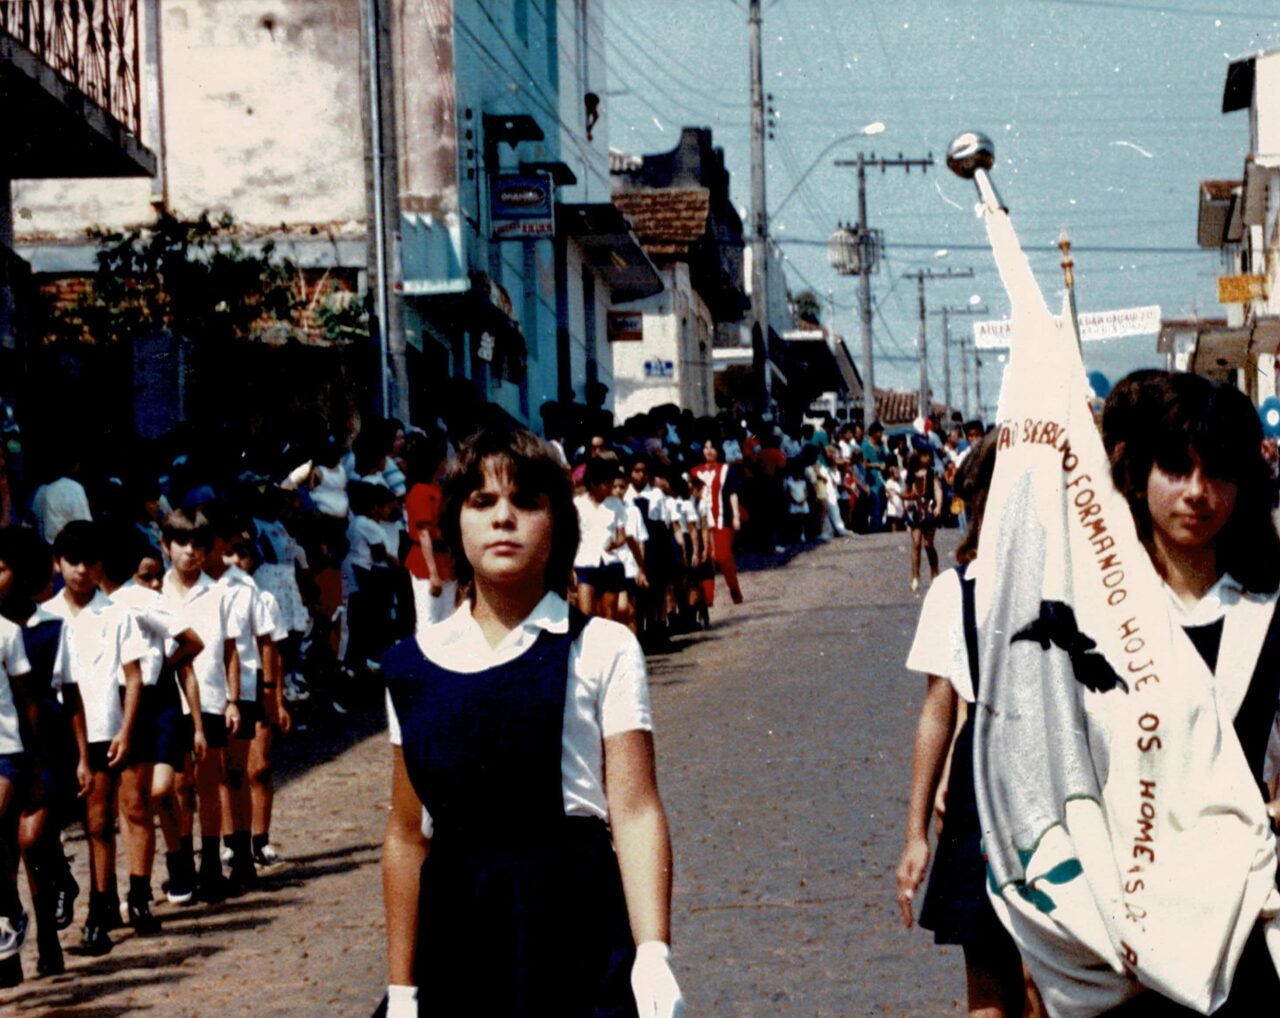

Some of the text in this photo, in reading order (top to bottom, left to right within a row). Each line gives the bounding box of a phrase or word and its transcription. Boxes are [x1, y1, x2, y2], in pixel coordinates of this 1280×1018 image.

[1064, 474, 1127, 606] FORMANDO
[1118, 616, 1160, 692] HOJE
[1136, 711, 1162, 753] OS
